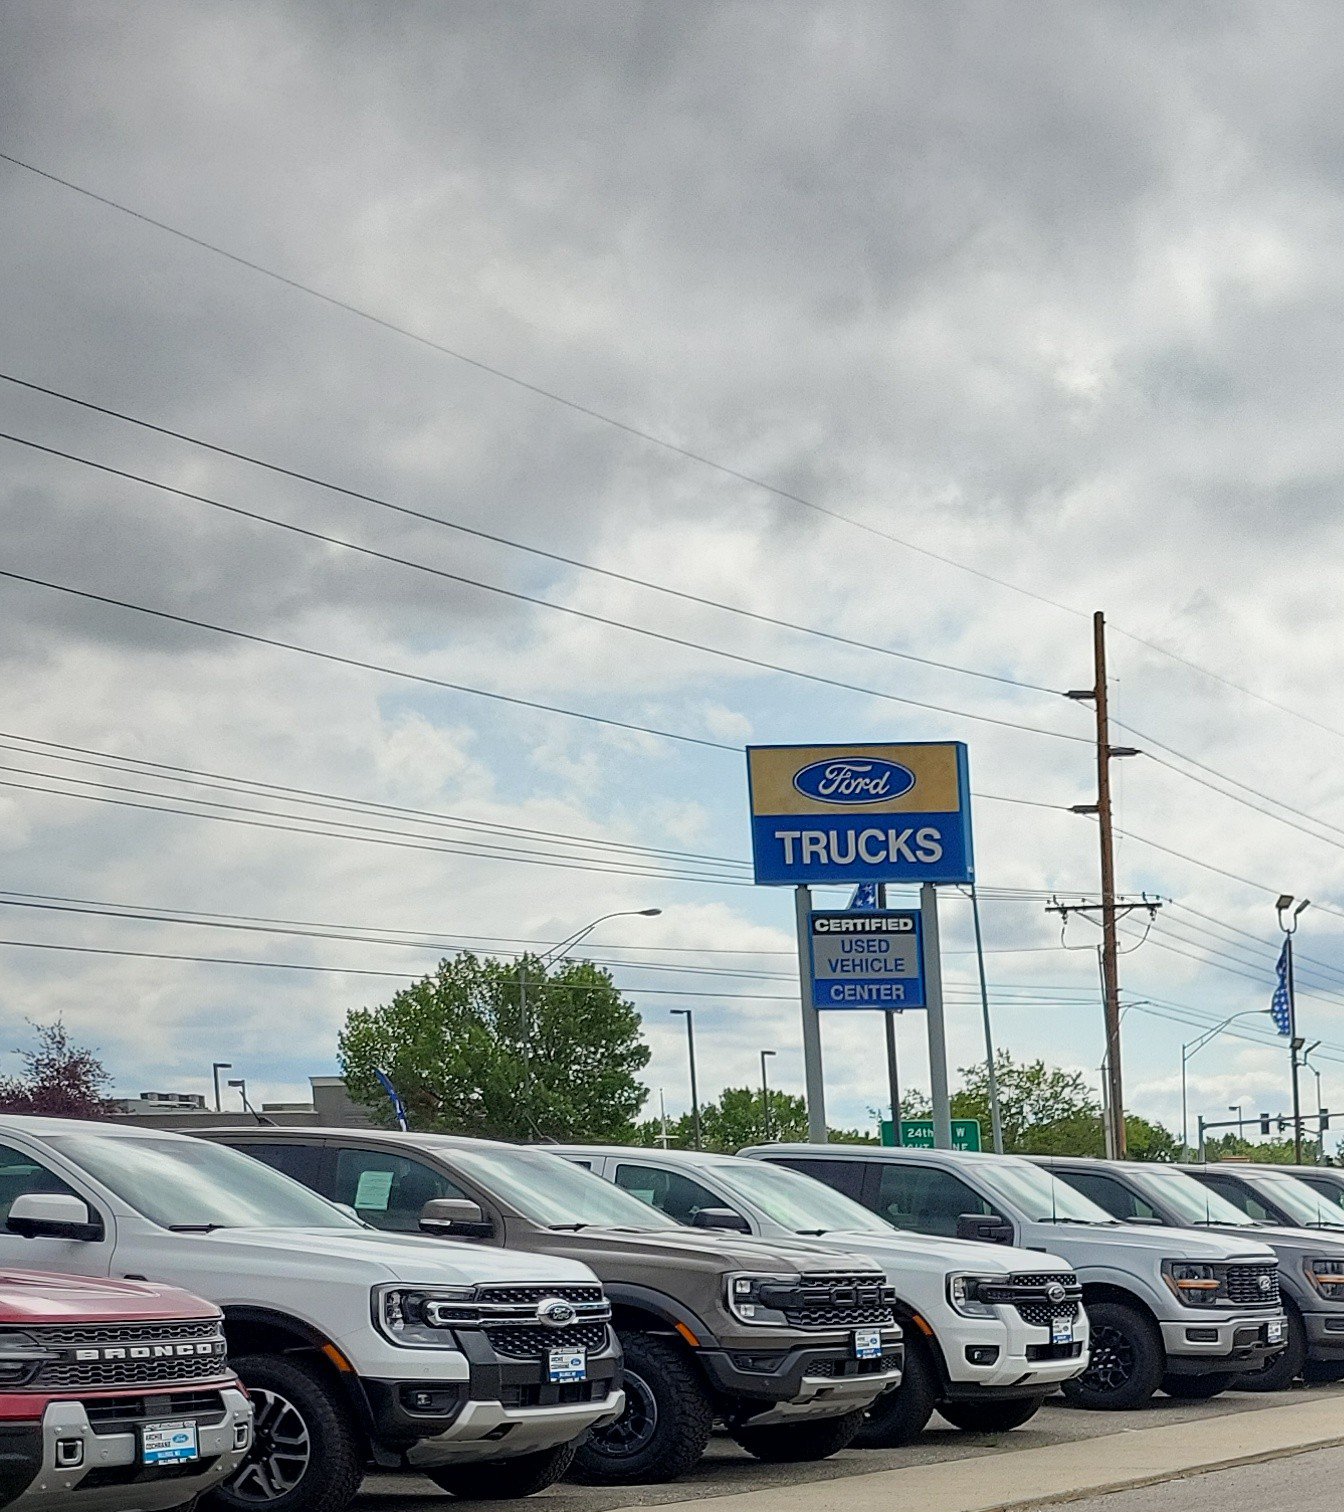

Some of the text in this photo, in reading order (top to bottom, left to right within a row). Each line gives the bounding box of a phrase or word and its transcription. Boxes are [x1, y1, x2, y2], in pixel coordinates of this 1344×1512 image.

[818, 764, 891, 795] Ford
[775, 827, 943, 865] TRUCKS
[815, 918, 913, 932] CERTIFIED
[841, 938, 891, 954] USED
[828, 957, 906, 973] VEHICLE
[830, 984, 905, 1001] CENTER
[907, 1127, 966, 1138] 24th W
[76, 1343, 212, 1361] BRONCO
